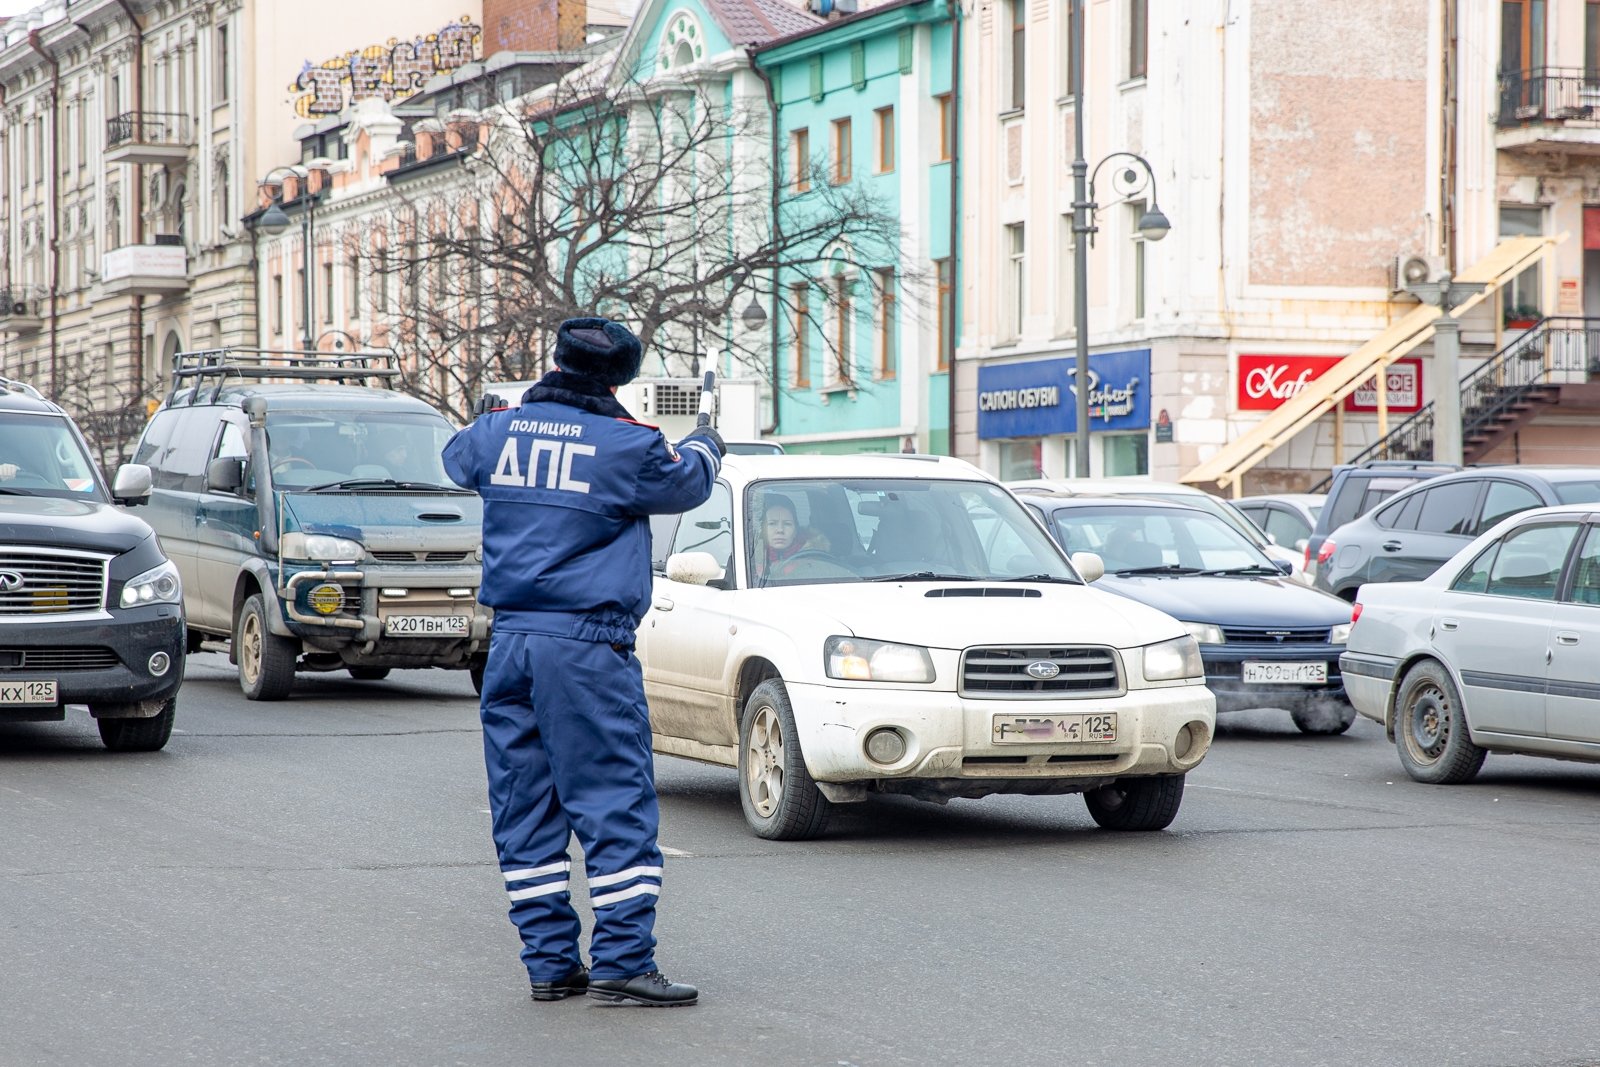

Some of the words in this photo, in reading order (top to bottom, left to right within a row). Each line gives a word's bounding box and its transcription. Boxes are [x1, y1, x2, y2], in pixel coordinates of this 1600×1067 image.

[1245, 364, 1314, 400] Kaf
[979, 391, 1017, 411] САЛОН
[1018, 386, 1058, 409] ОБУВИ
[509, 420, 582, 438] ПОЛИЦИЯ
[490, 437, 596, 494] ДПС
[446, 617, 464, 628] 125
[27, 682, 53, 696] 125
[1085, 716, 1111, 733] 125
